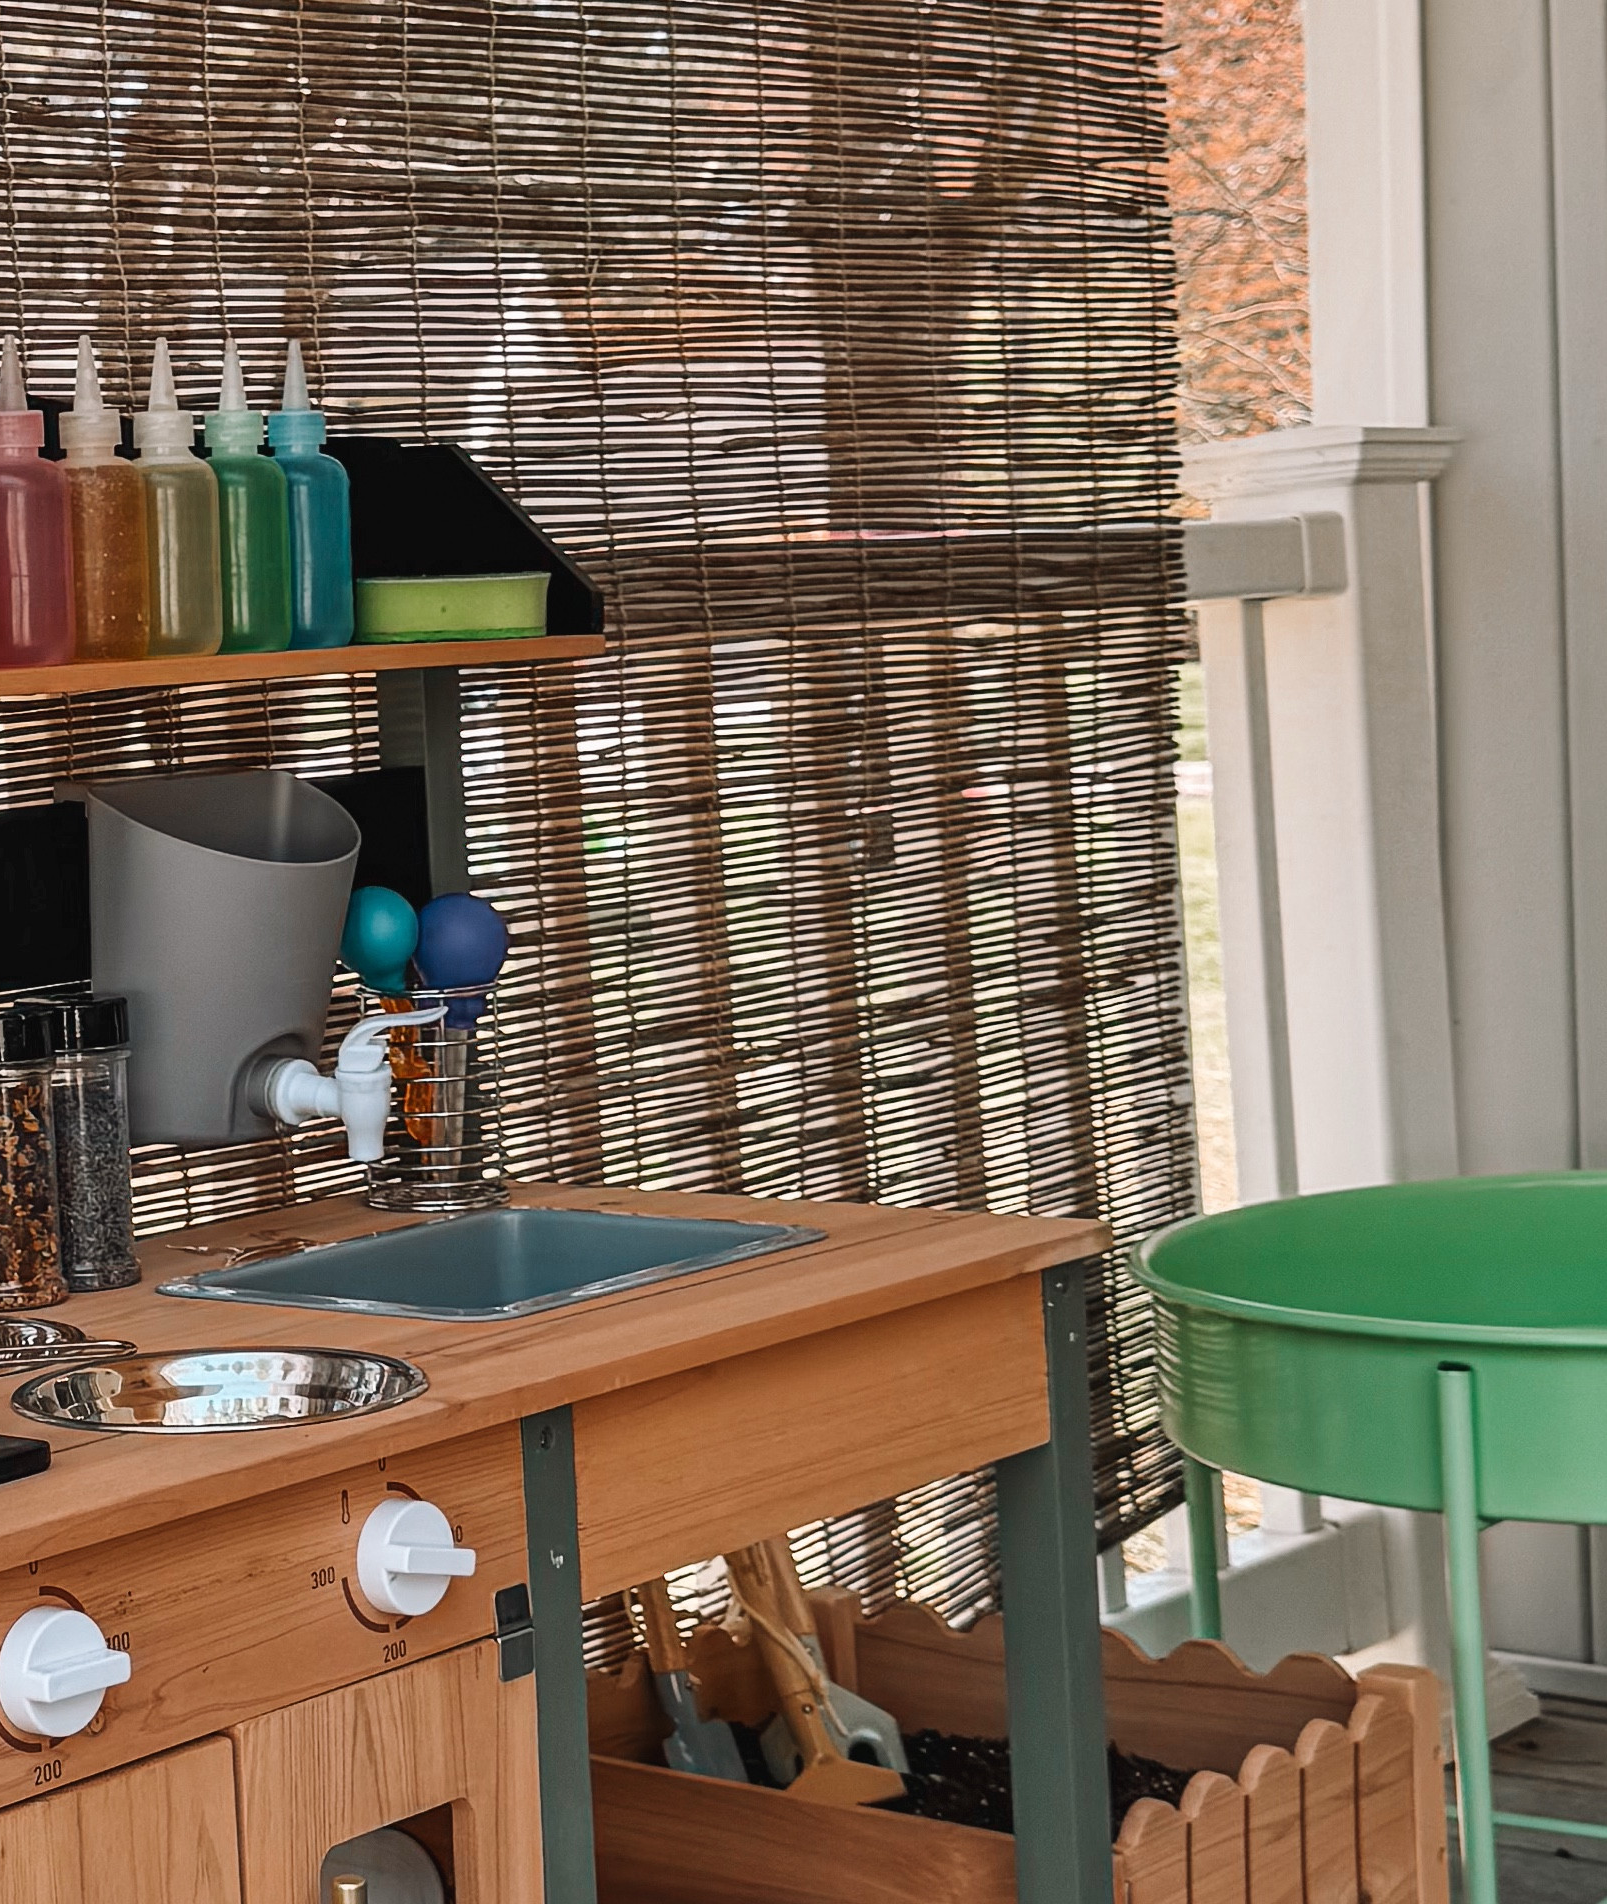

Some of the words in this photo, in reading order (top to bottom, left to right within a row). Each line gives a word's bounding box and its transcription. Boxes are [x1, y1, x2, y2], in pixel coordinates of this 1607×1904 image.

[310, 1566, 335, 1589] 300
[382, 1640, 407, 1663] 200
[33, 1760, 62, 1785] 200
